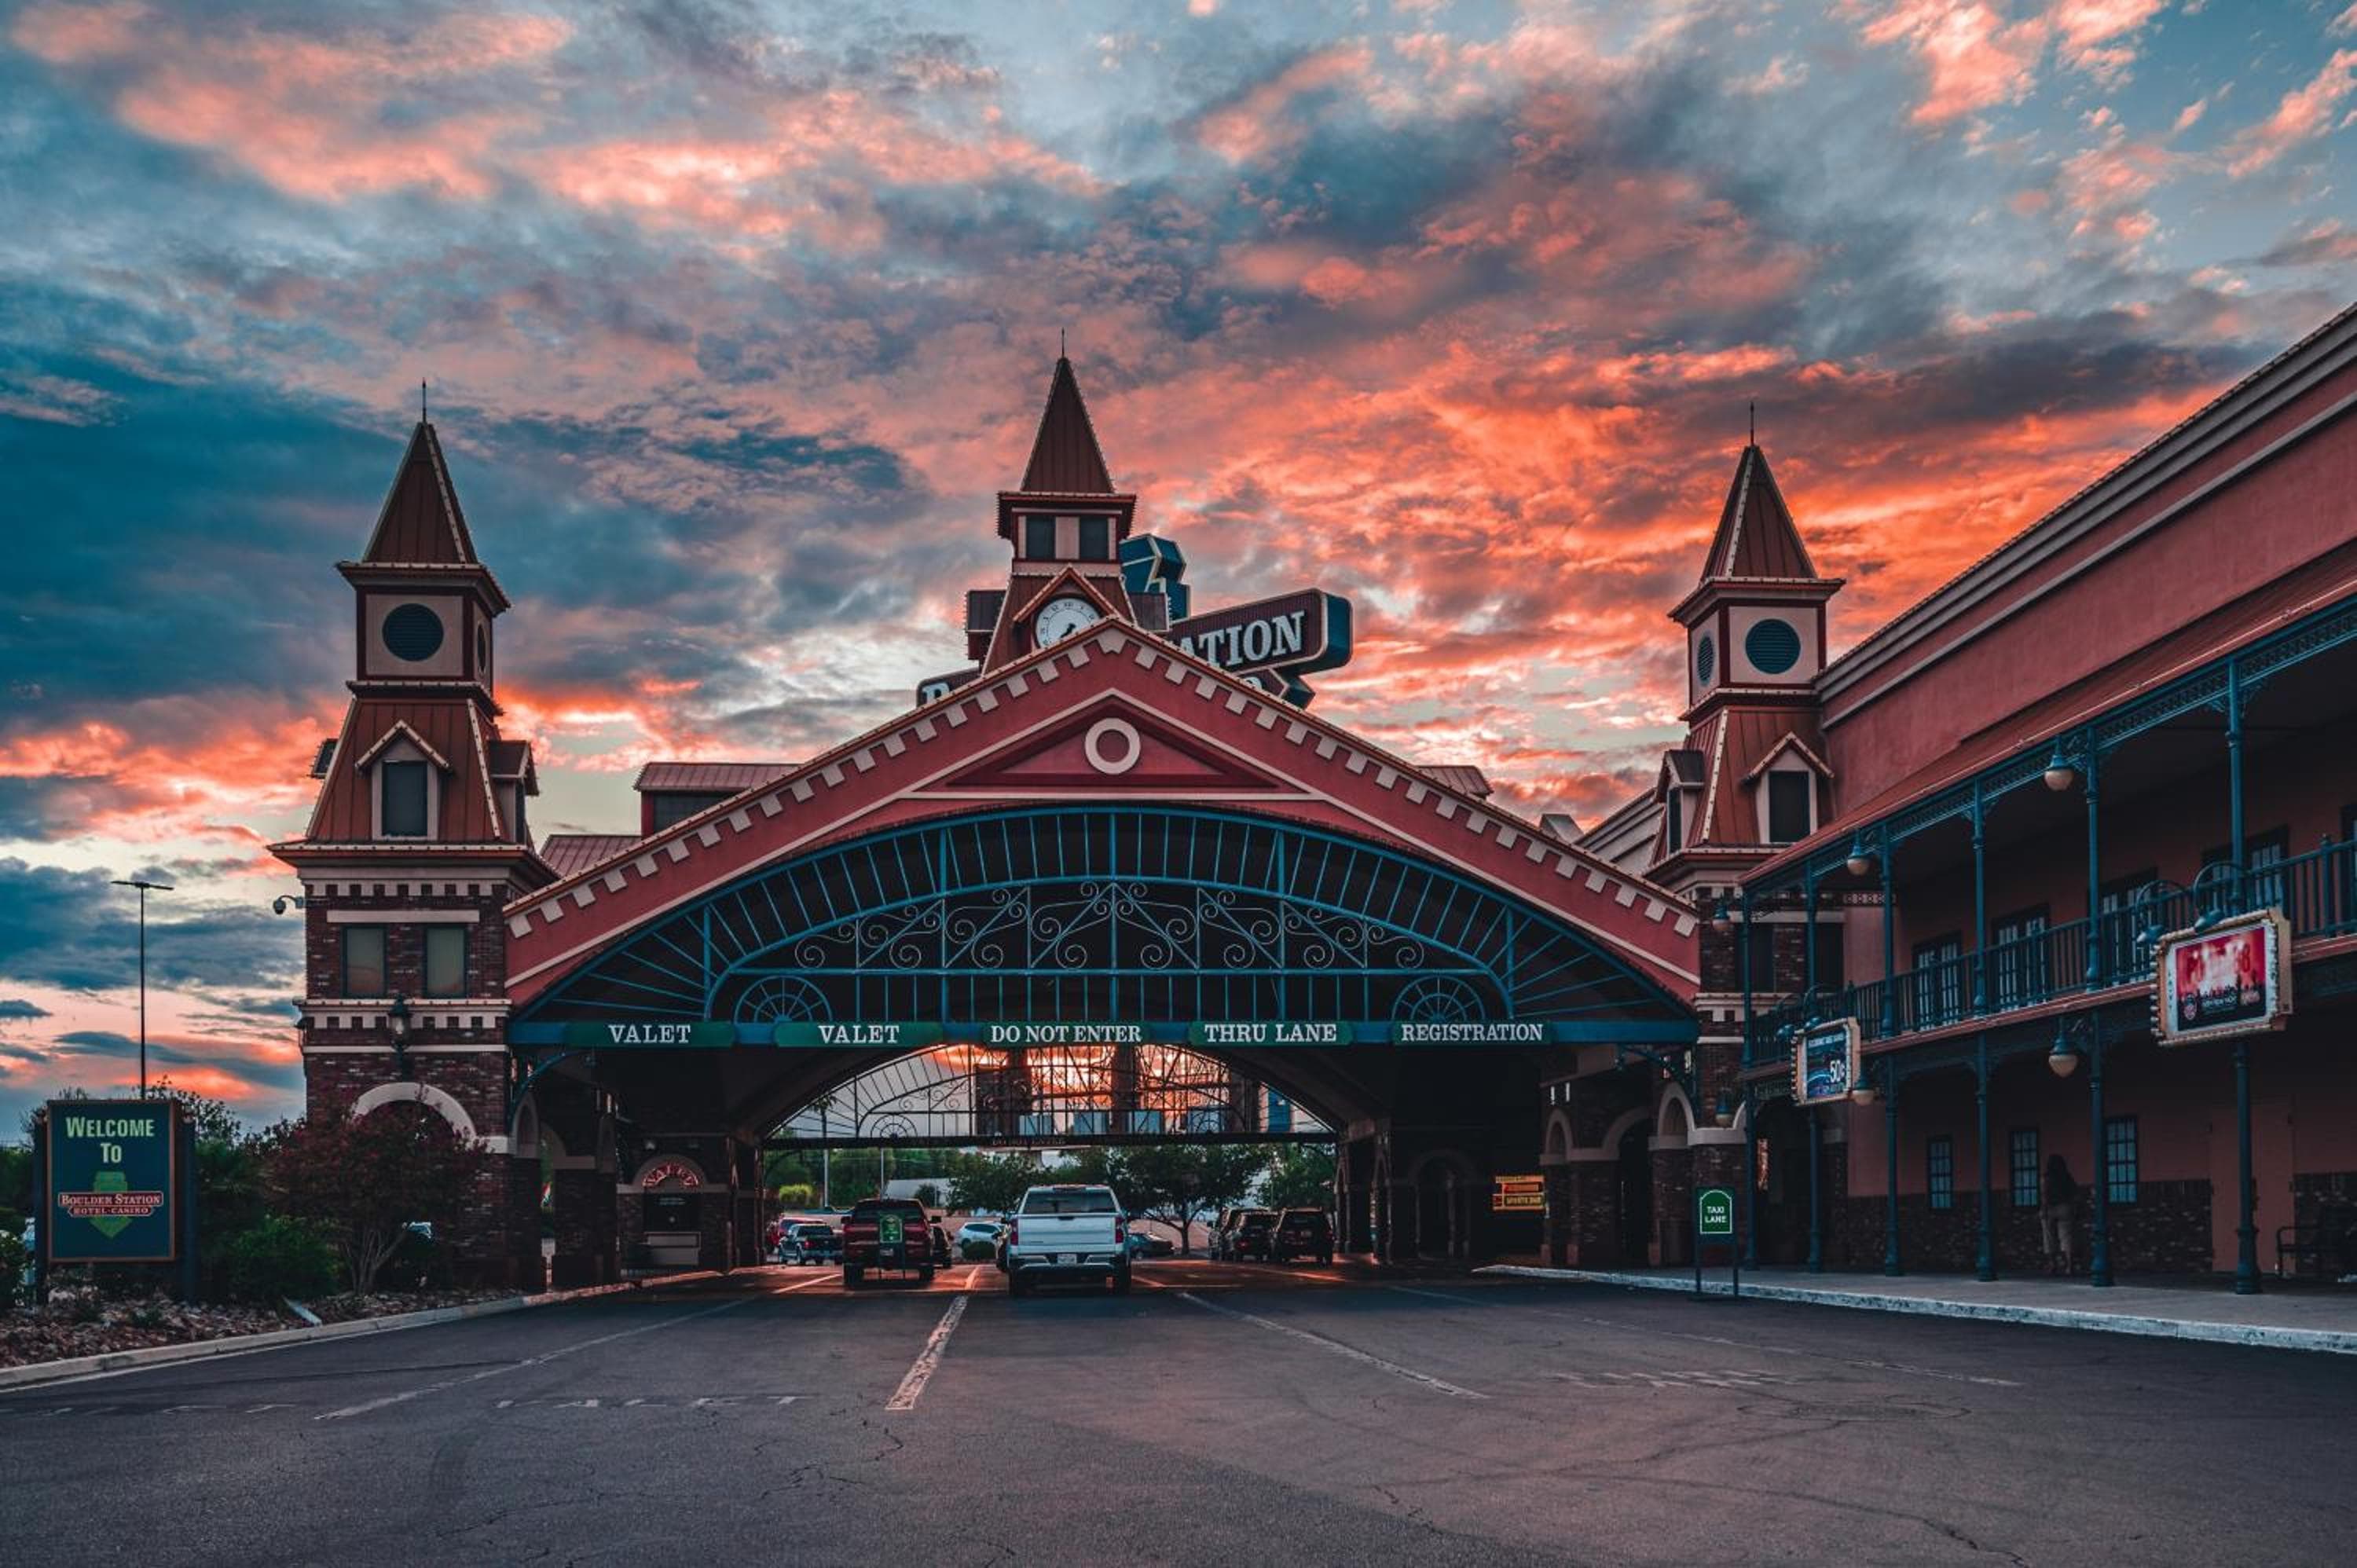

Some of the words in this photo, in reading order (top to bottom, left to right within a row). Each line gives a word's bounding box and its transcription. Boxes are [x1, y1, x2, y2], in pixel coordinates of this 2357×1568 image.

[608, 1024, 691, 1043] VALET
[817, 1024, 900, 1043] VALET
[991, 1025, 1021, 1042] DO
[1025, 1025, 1069, 1042] NOT
[1071, 1025, 1142, 1042] ENTER
[1204, 1024, 1267, 1042] THRU
[1275, 1024, 1337, 1042] LANE
[1401, 1023, 1544, 1042] REGISTRATION
[66, 1117, 154, 1138] WELCOME
[62, 1195, 112, 1204] BOULDER
[115, 1193, 160, 1204] STATION
